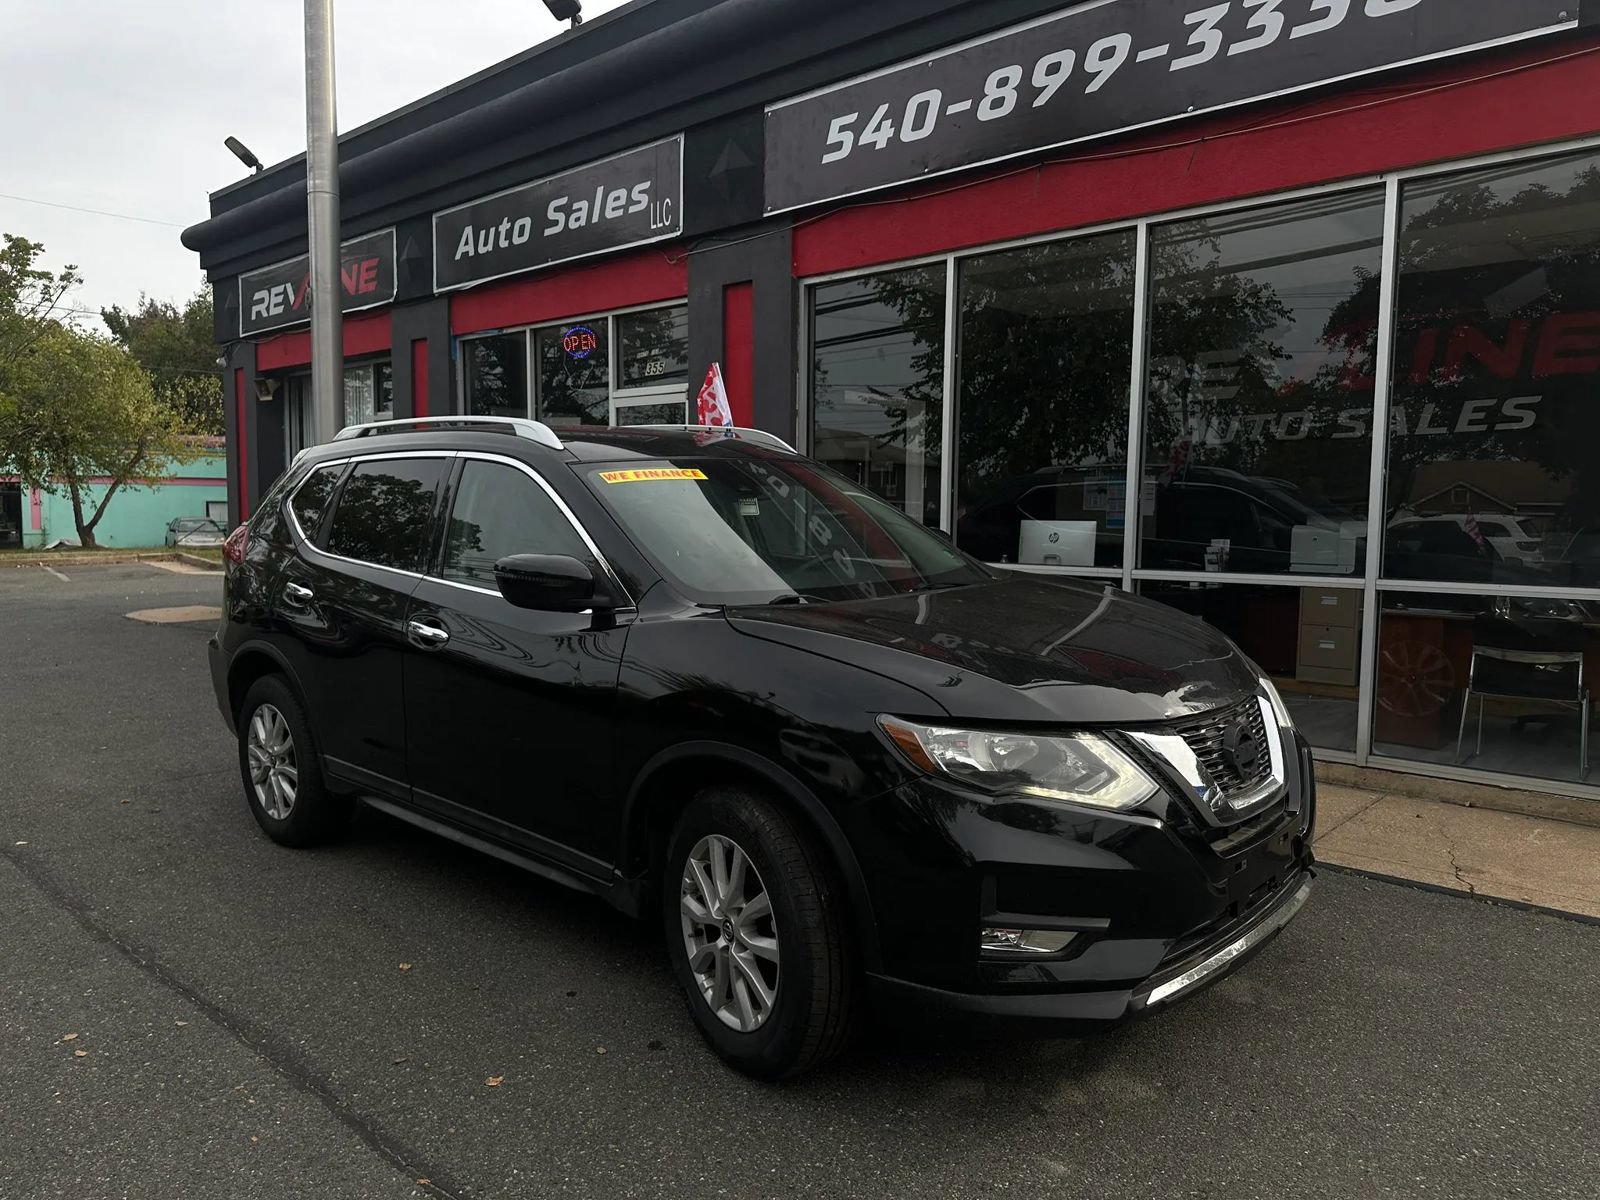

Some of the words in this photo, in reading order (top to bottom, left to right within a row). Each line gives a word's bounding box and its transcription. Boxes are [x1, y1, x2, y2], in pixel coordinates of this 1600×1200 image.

[455, 217, 532, 260] Auto
[544, 180, 651, 236] Sales
[650, 198, 672, 229] LLC
[563, 333, 596, 352] OPEN
[646, 361, 665, 375] 355
[602, 471, 630, 481] WE
[633, 469, 702, 480] FINANCE
